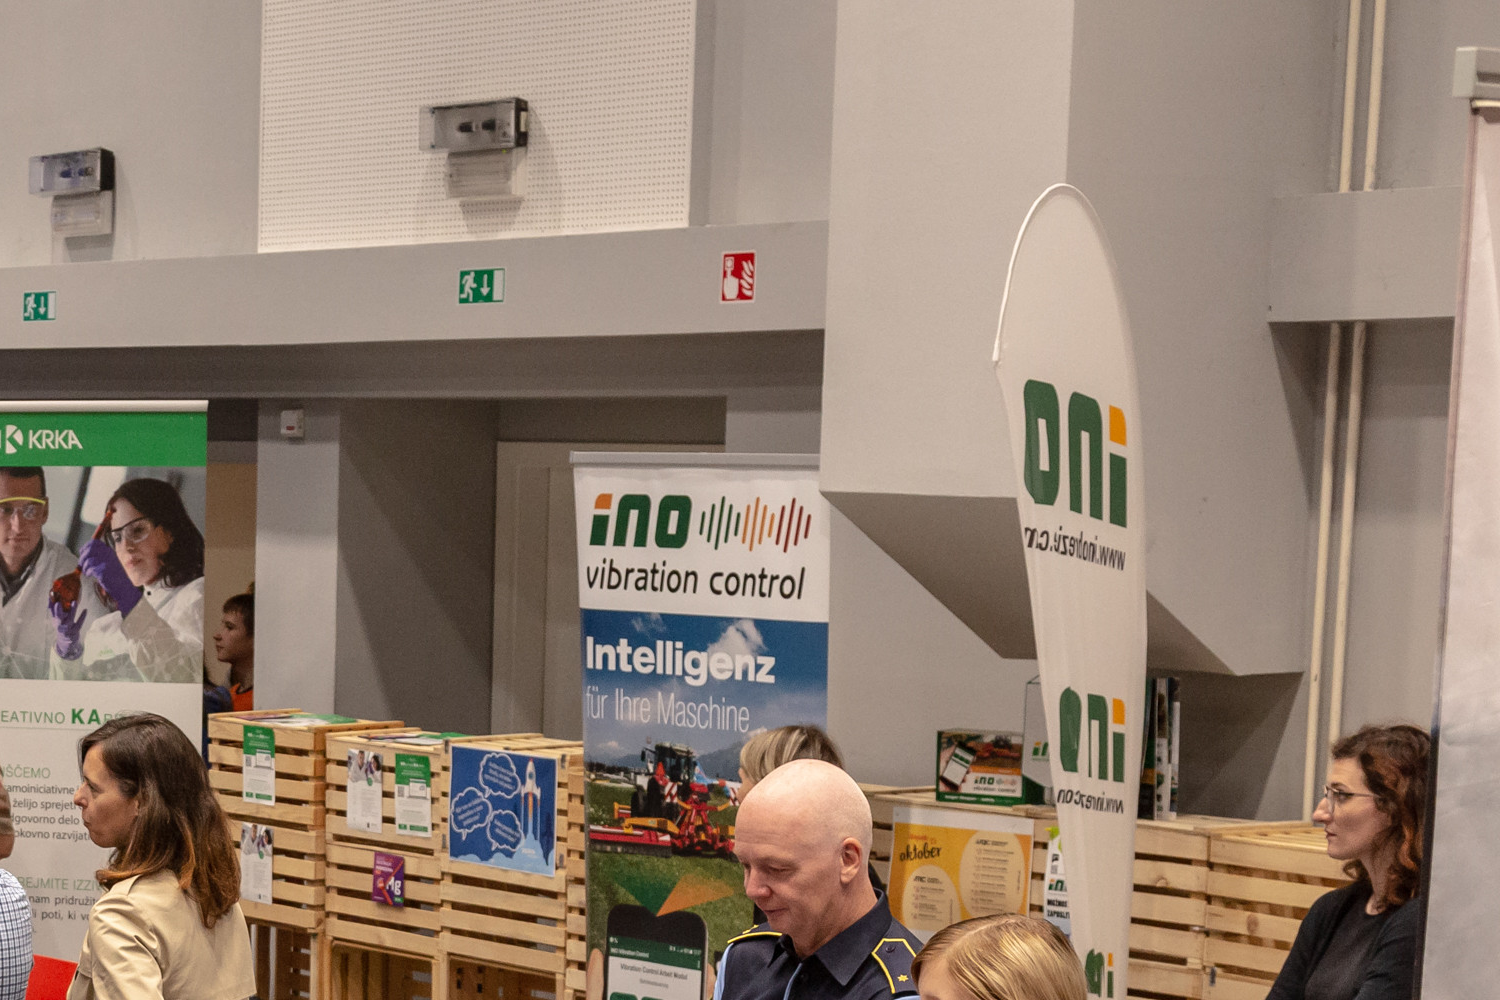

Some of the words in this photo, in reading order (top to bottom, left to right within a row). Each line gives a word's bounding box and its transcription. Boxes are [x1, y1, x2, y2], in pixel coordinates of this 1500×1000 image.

[29, 429, 83, 450] KRKA
[589, 493, 693, 549] ino
[586, 557, 699, 594] vibration
[709, 566, 806, 600] control
[586, 636, 776, 687] Intelligenz
[585, 685, 609, 720] für
[615, 688, 651, 724] Ihre
[657, 691, 750, 733] Maschine
[12, 798, 38, 811] želijo
[58, 815, 80, 825] delo
[13, 829, 50, 840] okovno
[899, 842, 942, 862] oktober
[18, 876, 69, 890] REJMITE
[1048, 878, 1067, 892] in
[28, 895, 50, 905] nam
[68, 911, 76, 920] ki
